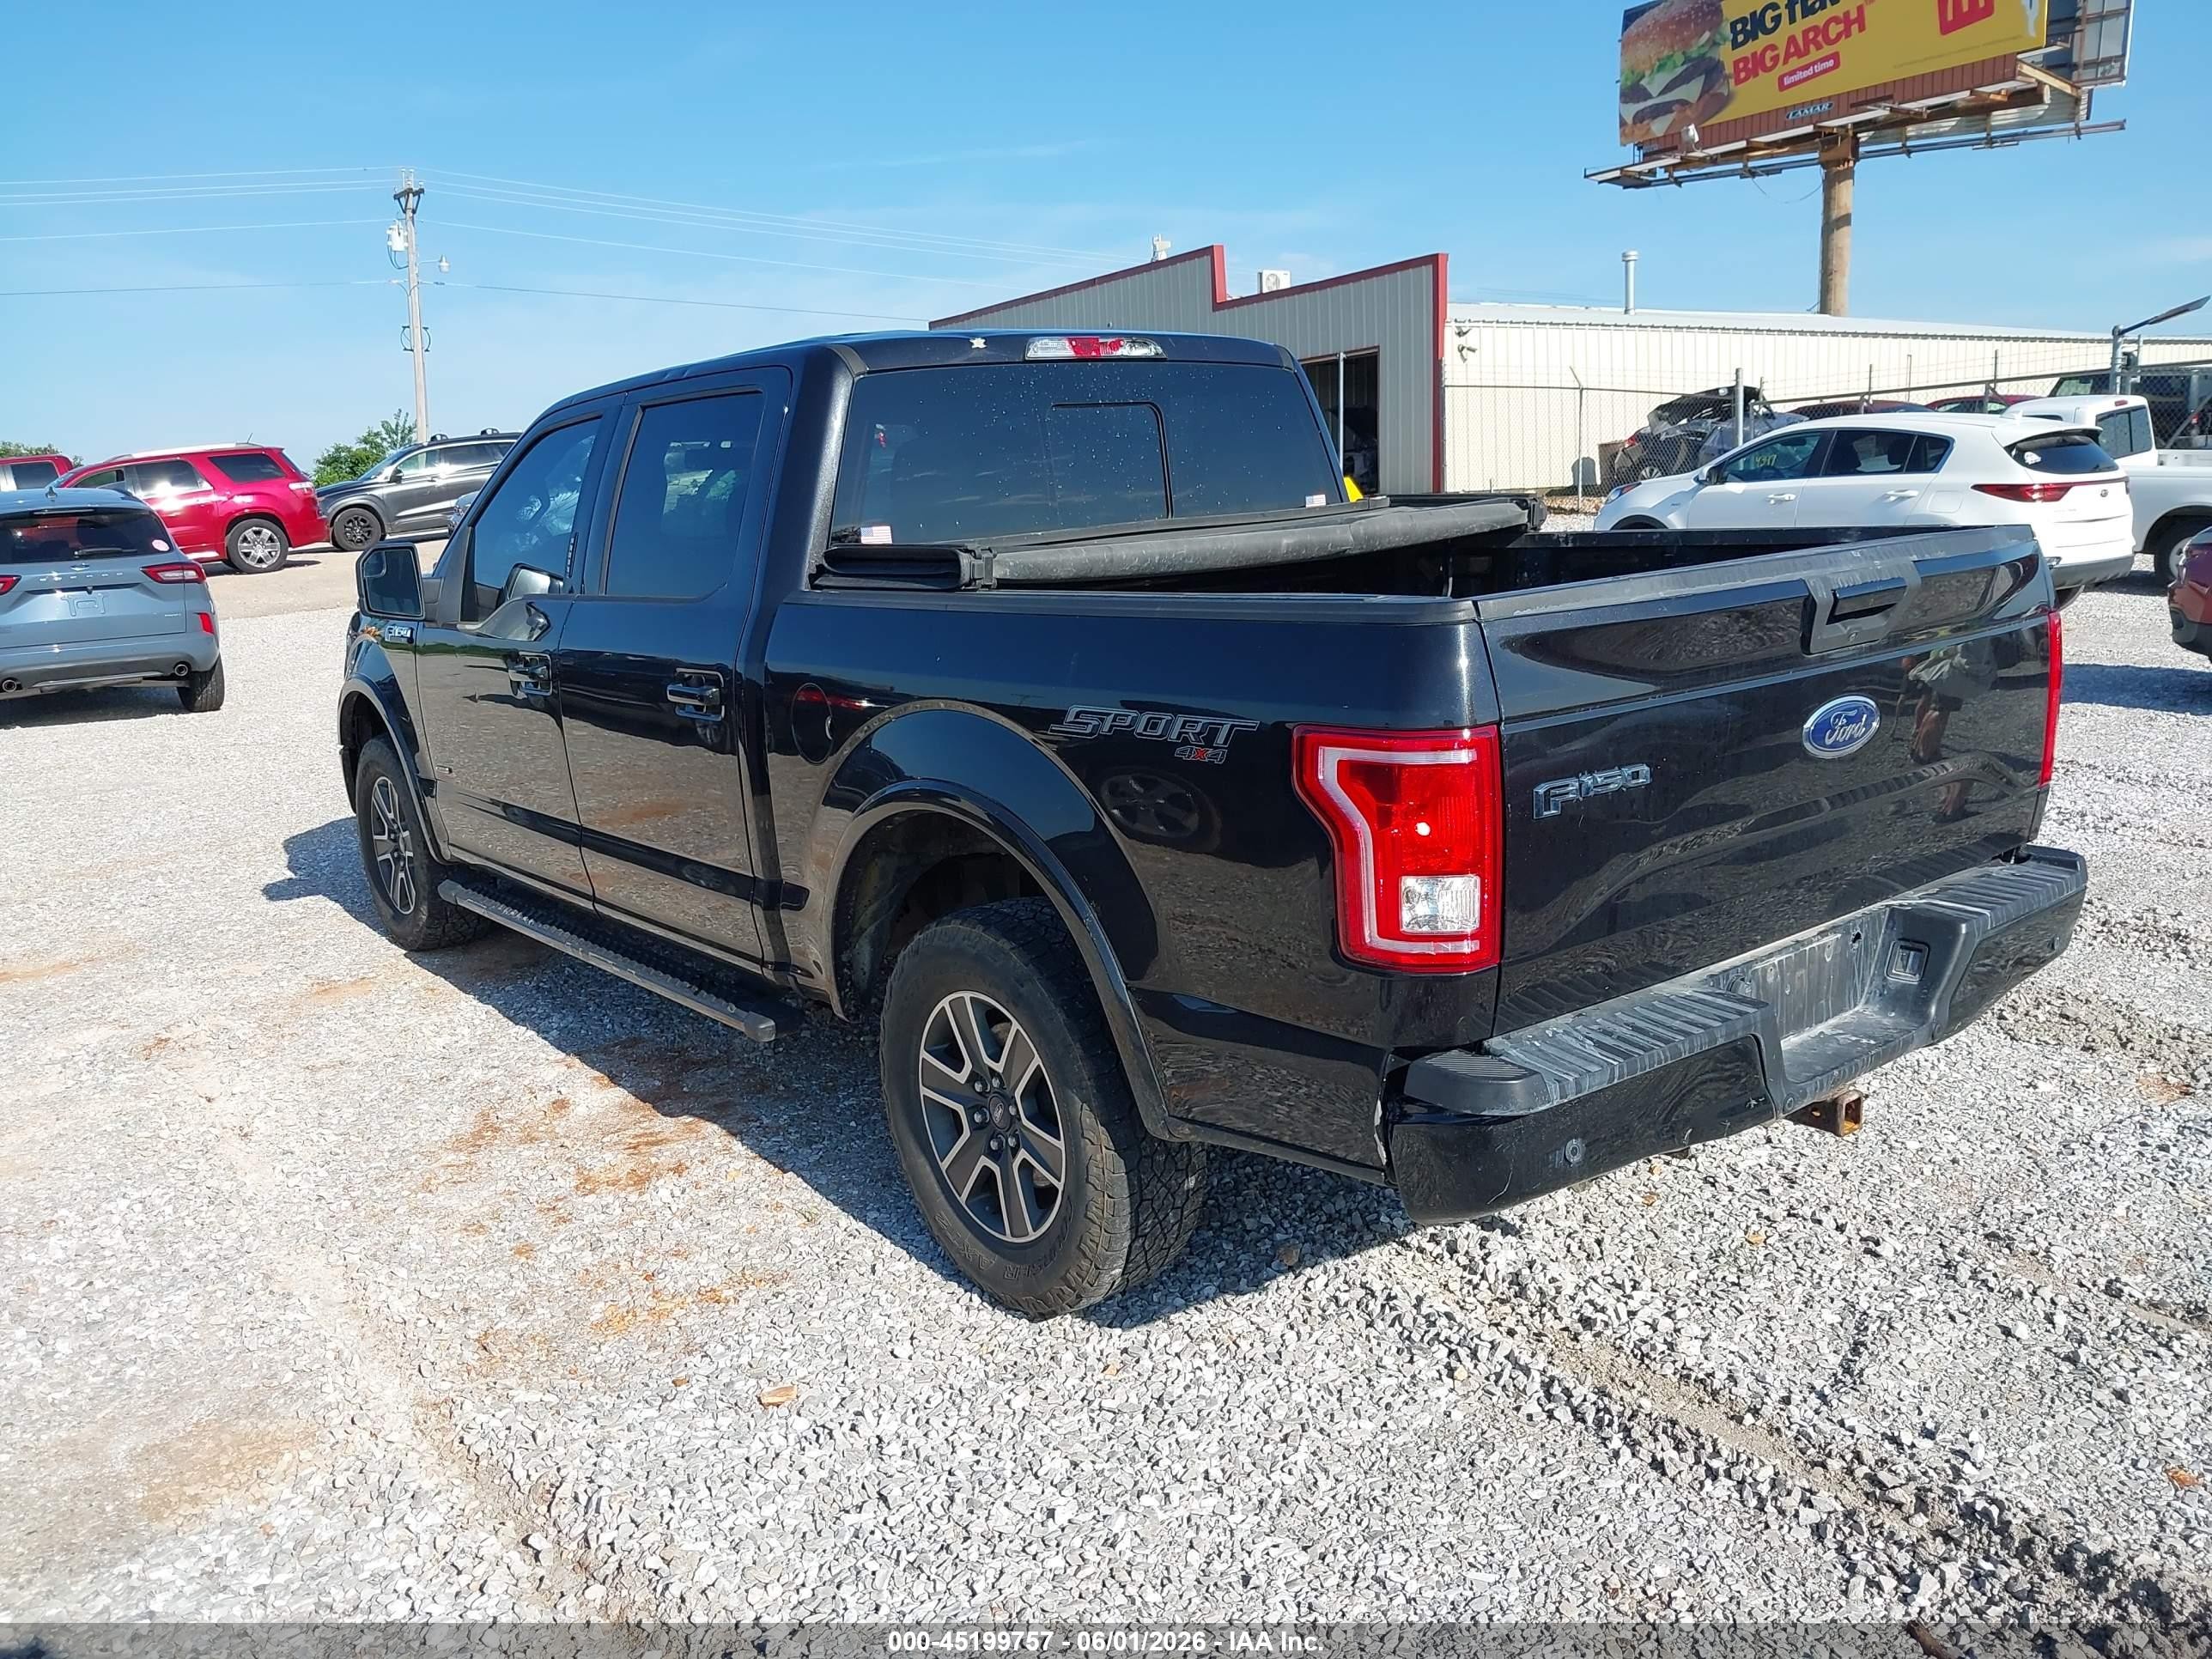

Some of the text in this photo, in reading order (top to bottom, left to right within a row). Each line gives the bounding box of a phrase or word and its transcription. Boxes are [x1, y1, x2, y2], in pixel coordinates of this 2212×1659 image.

[1729, 2, 1783, 51] BIG
[1732, 43, 1780, 86] BIG
[1783, 3, 1867, 65] ARCH
[1784, 58, 1834, 86] limited time
[1048, 704, 1261, 747] SPORT
